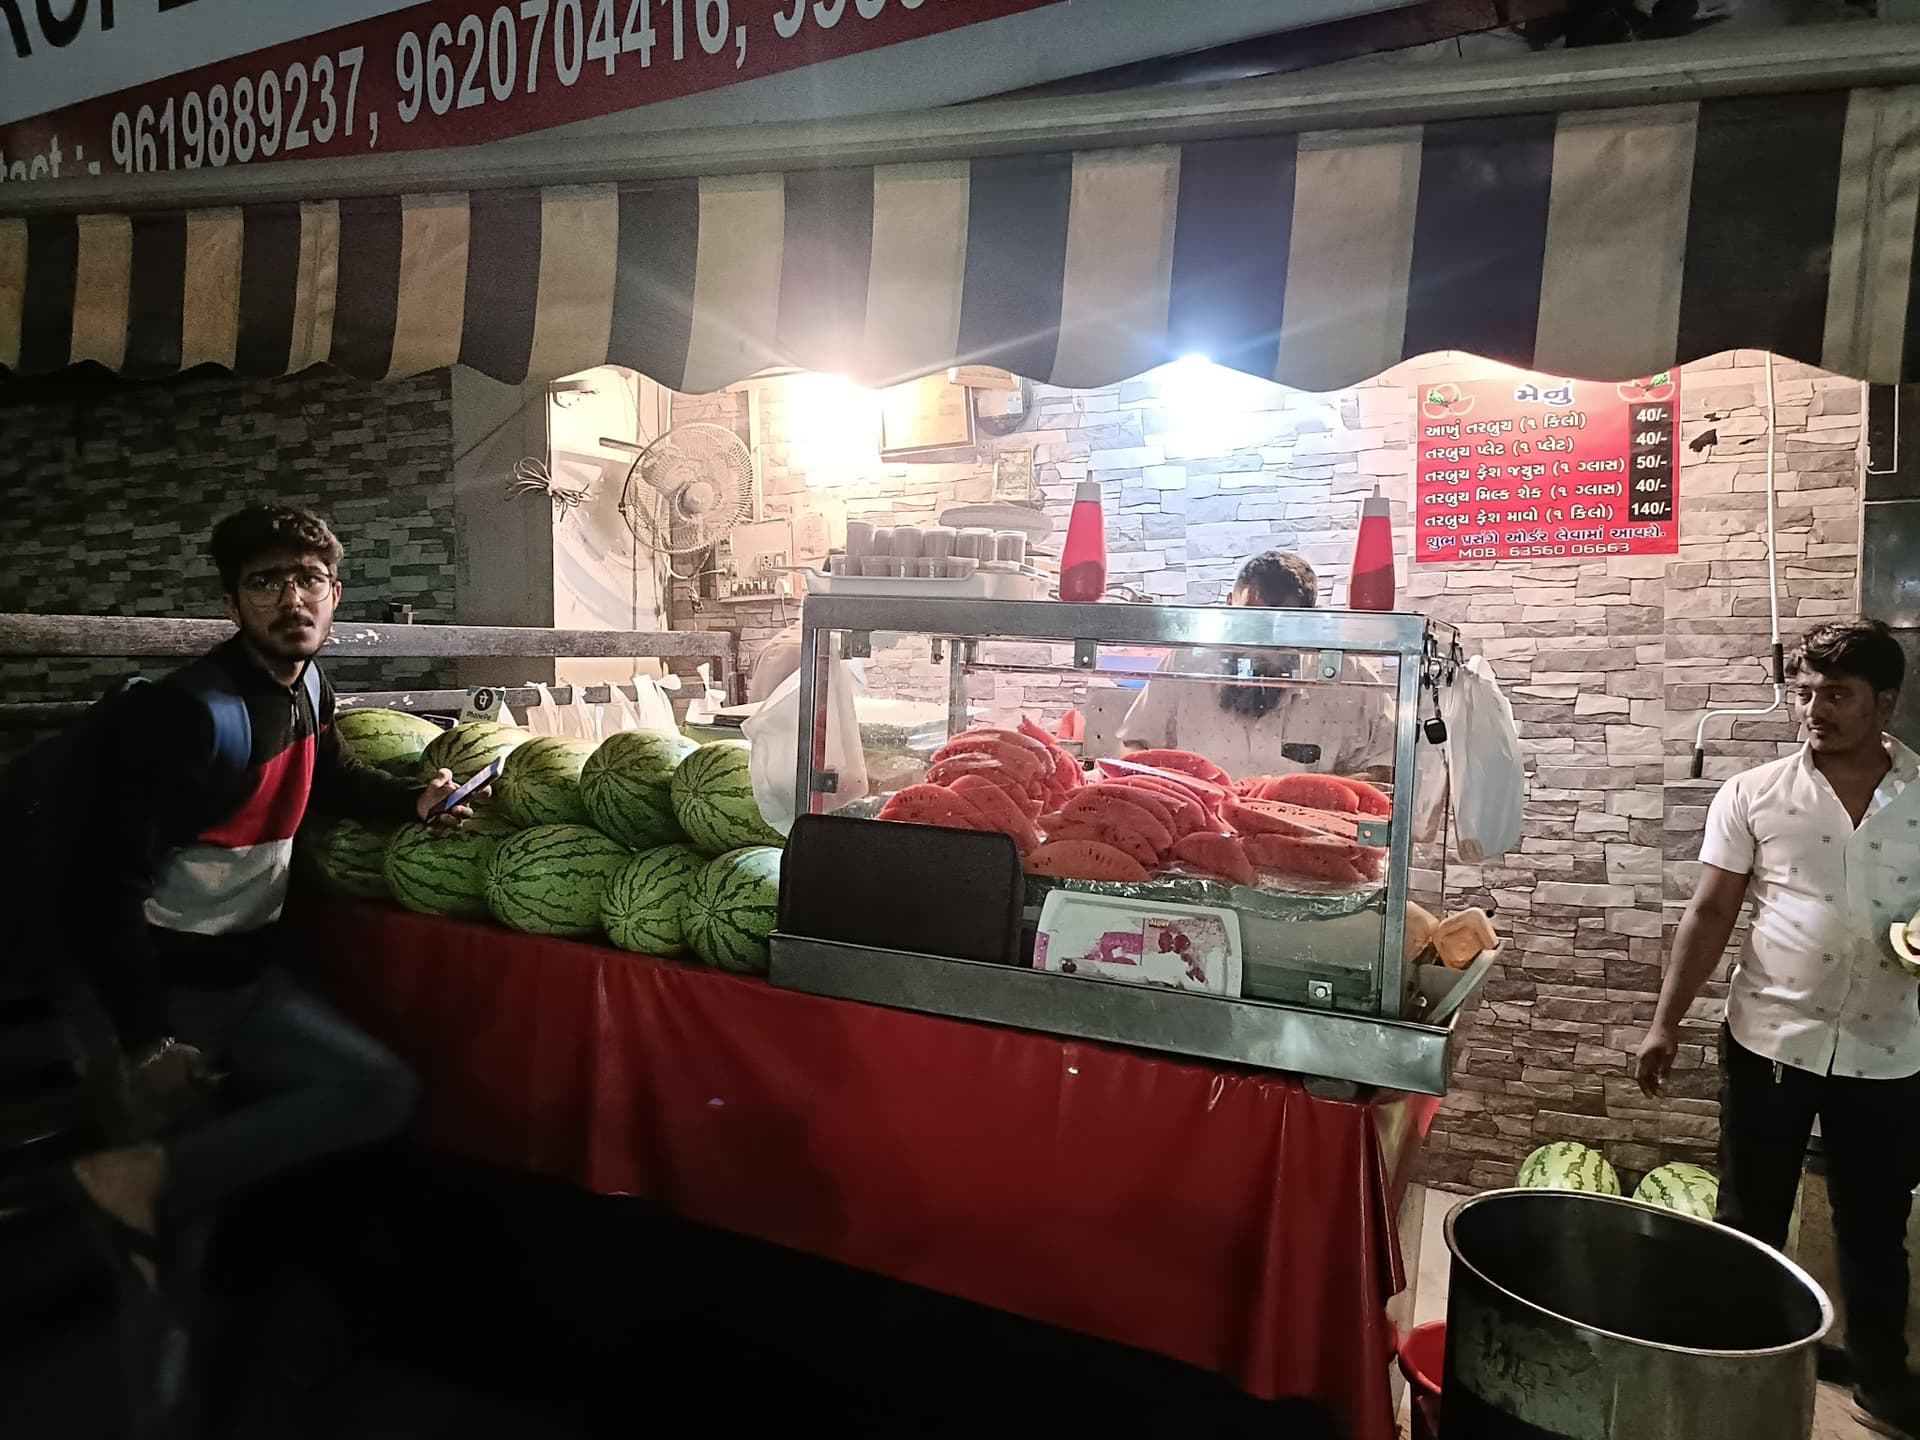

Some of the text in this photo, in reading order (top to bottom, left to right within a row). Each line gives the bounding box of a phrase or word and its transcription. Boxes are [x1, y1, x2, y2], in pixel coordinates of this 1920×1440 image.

[112, 46, 377, 173] 9619889237,
[1425, 419, 1460, 440] આખું
[1543, 411, 1587, 429] કિલો)
[1636, 408, 1668, 422] 40/-
[1476, 441, 1505, 456] પ્લેટ
[1536, 436, 1574, 452] પ્લેટ)
[1636, 432, 1668, 445] 40/-
[1577, 458, 1625, 473] ગ્લાસ)
[1636, 455, 1667, 469] 50/-
[1475, 486, 1510, 501] મિલ્ક
[1517, 484, 1542, 499] શેક
[1575, 481, 1623, 497] ગ્લાસ)
[1635, 479, 1667, 492] 40/-
[1506, 507, 1538, 522] માવો
[1570, 503, 1613, 521] કિલો)
[1631, 502, 1671, 516] 140/-
[1427, 536, 1456, 551] શુભ
[1462, 530, 1499, 545] પ્રસંગે
[1555, 524, 1605, 541] લેવામાં
[1509, 545, 1566, 557] 63560
[1571, 542, 1630, 554] 06663
